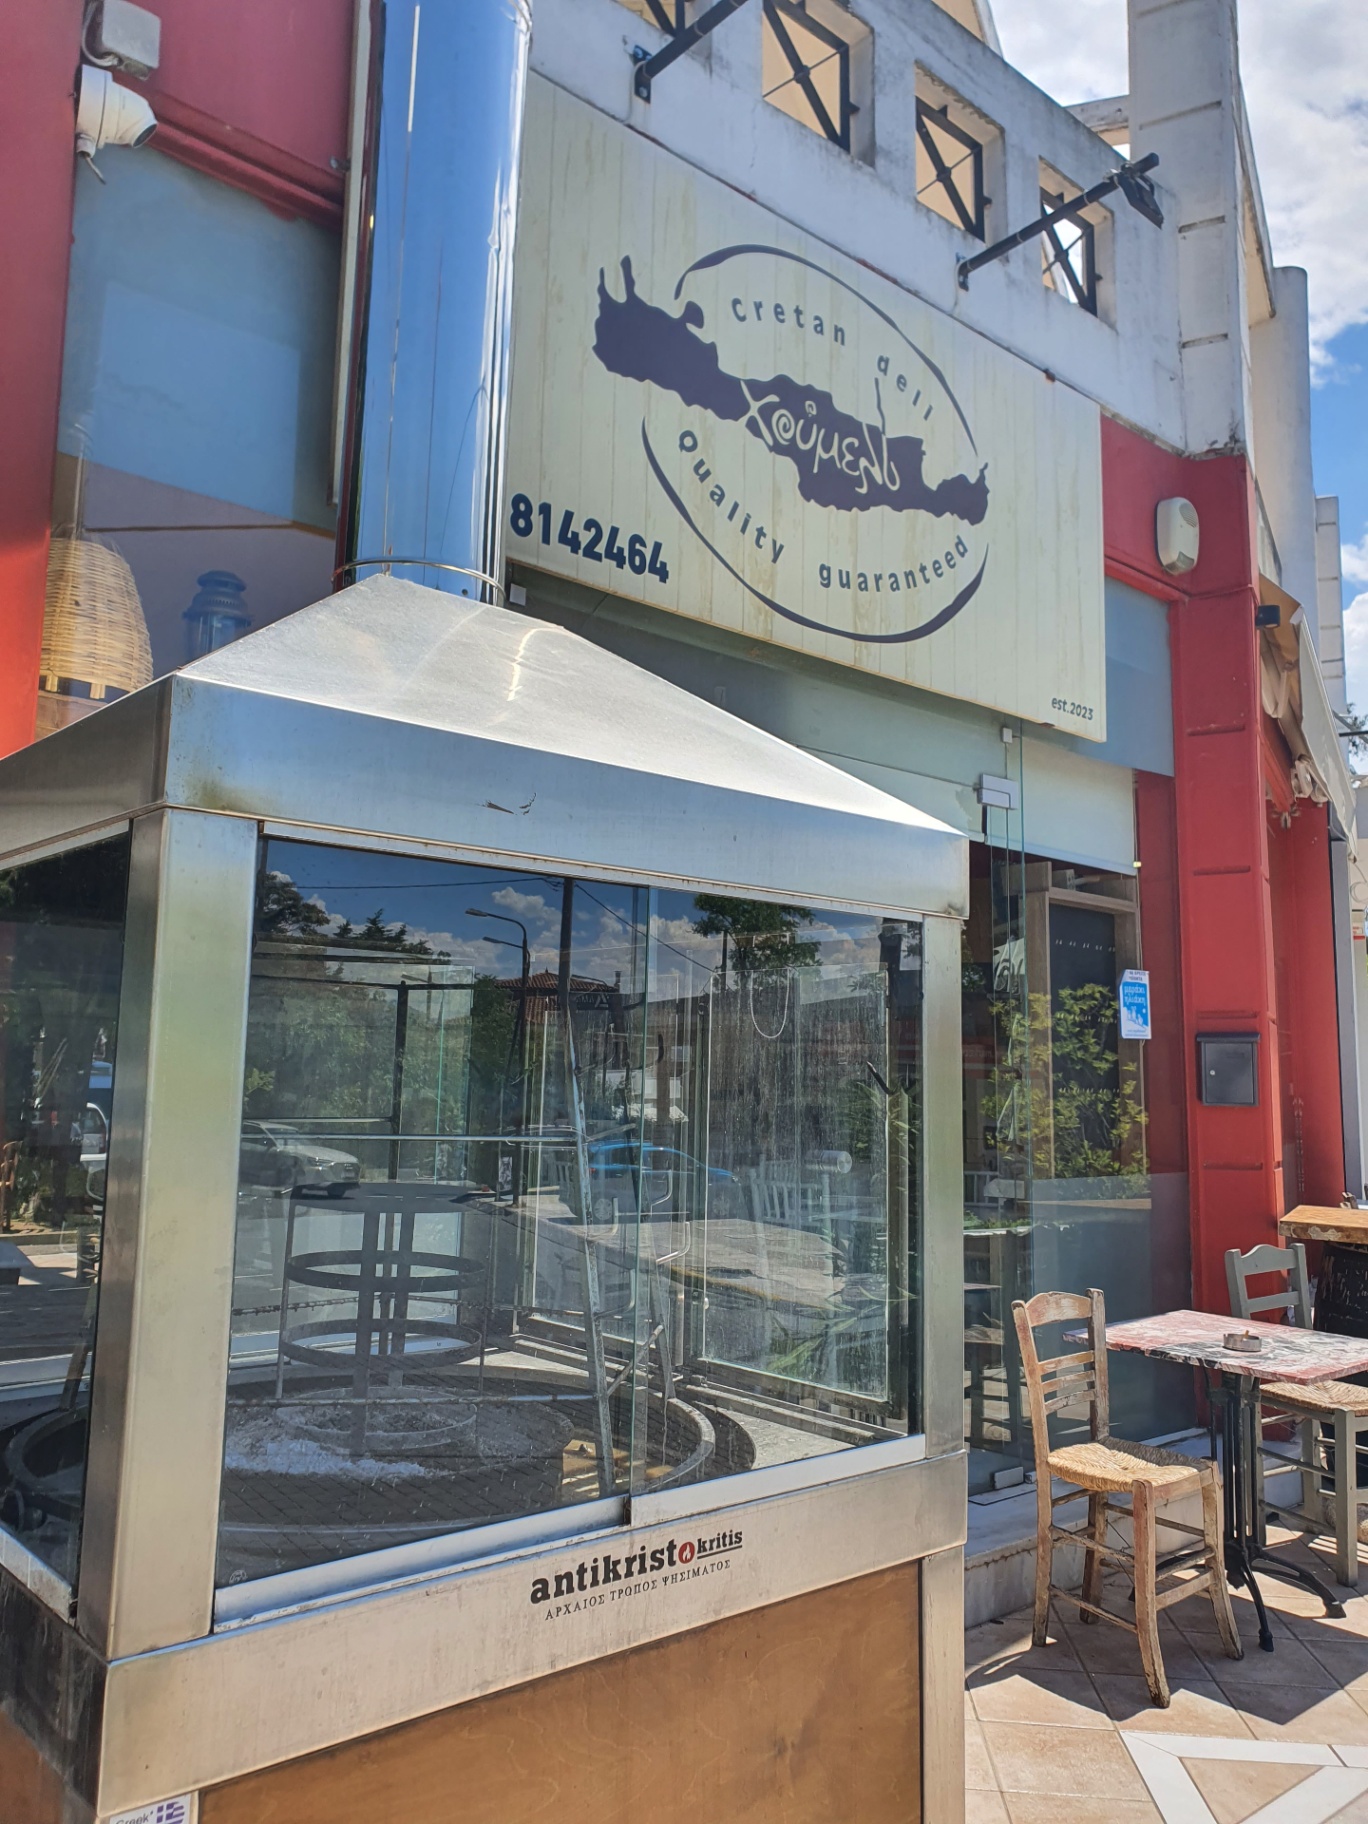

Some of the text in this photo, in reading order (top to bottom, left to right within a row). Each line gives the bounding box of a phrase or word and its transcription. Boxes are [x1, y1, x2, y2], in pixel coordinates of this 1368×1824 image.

[731, 298, 845, 346] cretan
[510, 493, 669, 584] 8142464
[679, 430, 968, 592] Quality guaranteed
[1051, 697, 1094, 721] est.2023
[530, 1530, 743, 1604] antikristo kritis
[545, 1559, 732, 1621] ΑΡΧΑΙΟΣ ΤΡΟΠΟΣ ΨΗΣΙΜΑΤΟΣ
